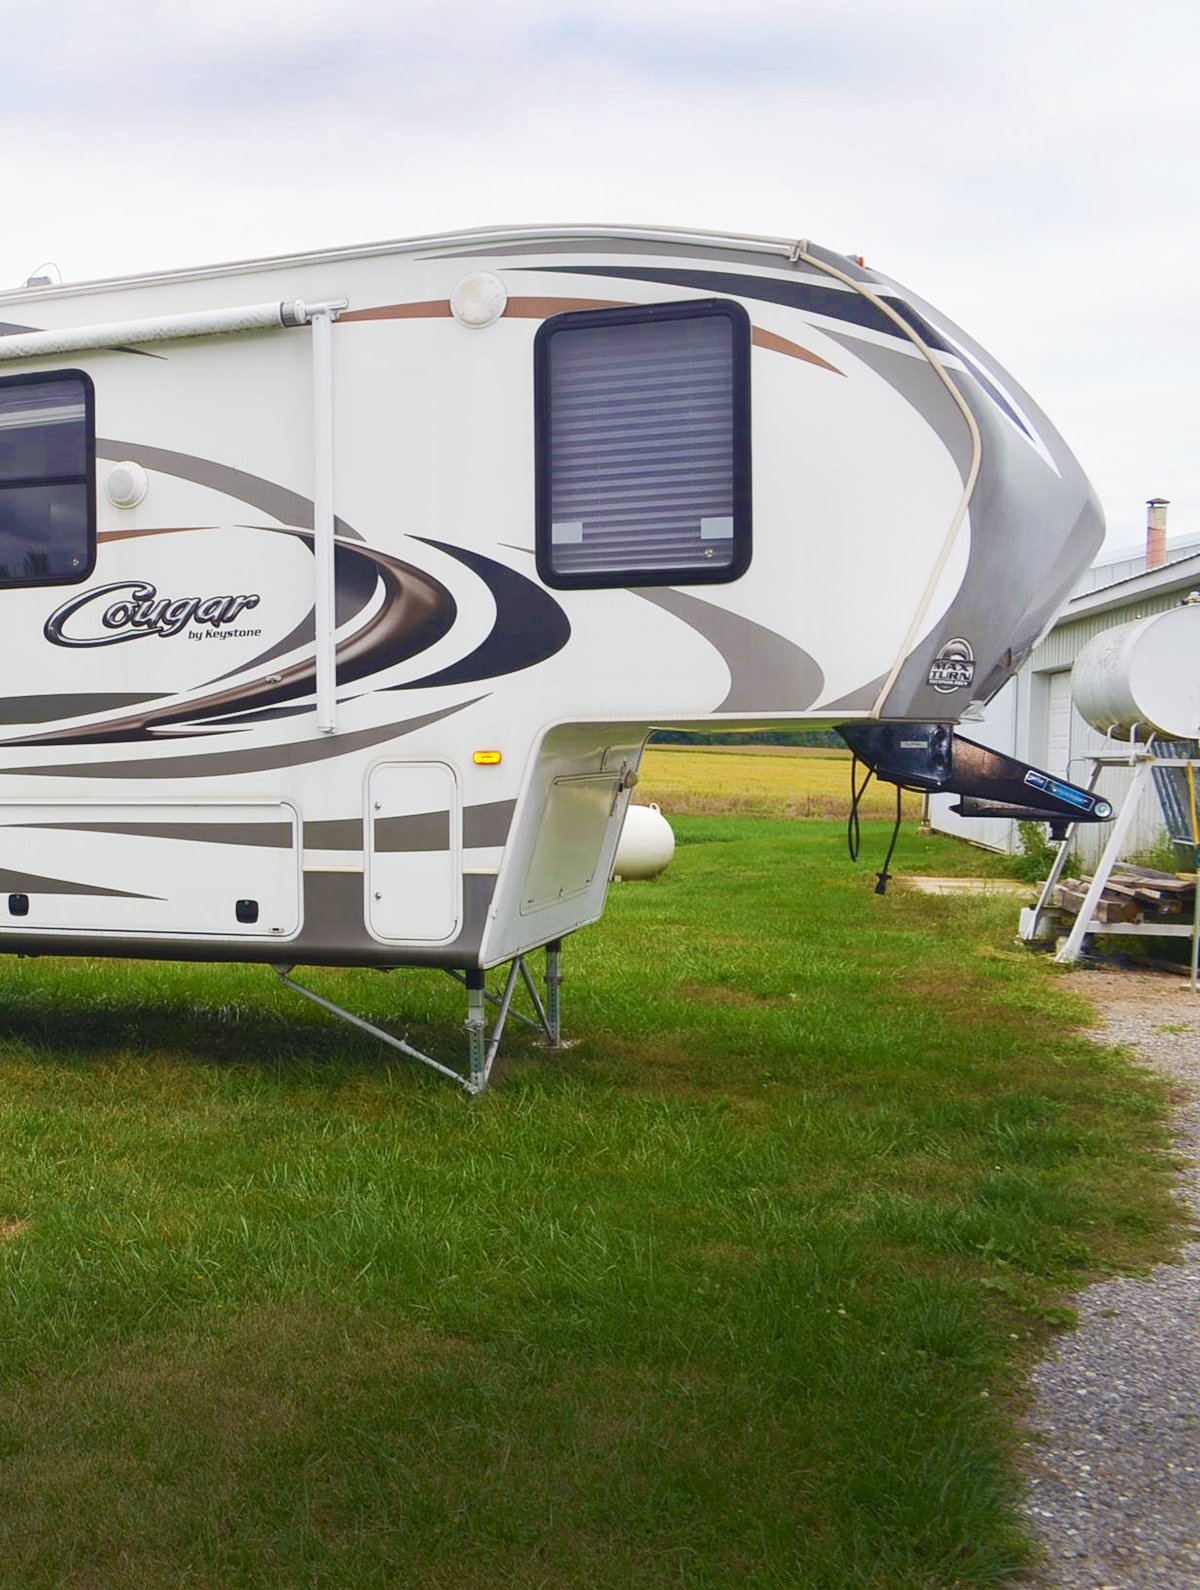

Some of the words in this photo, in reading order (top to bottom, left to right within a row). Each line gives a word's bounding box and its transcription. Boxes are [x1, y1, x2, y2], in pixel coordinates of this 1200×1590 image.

[44, 581, 260, 648] Cougar
[188, 630, 203, 641] by
[205, 629, 262, 641] Keystone
[933, 662, 970, 672] MAX
[931, 670, 970, 680] TURN
